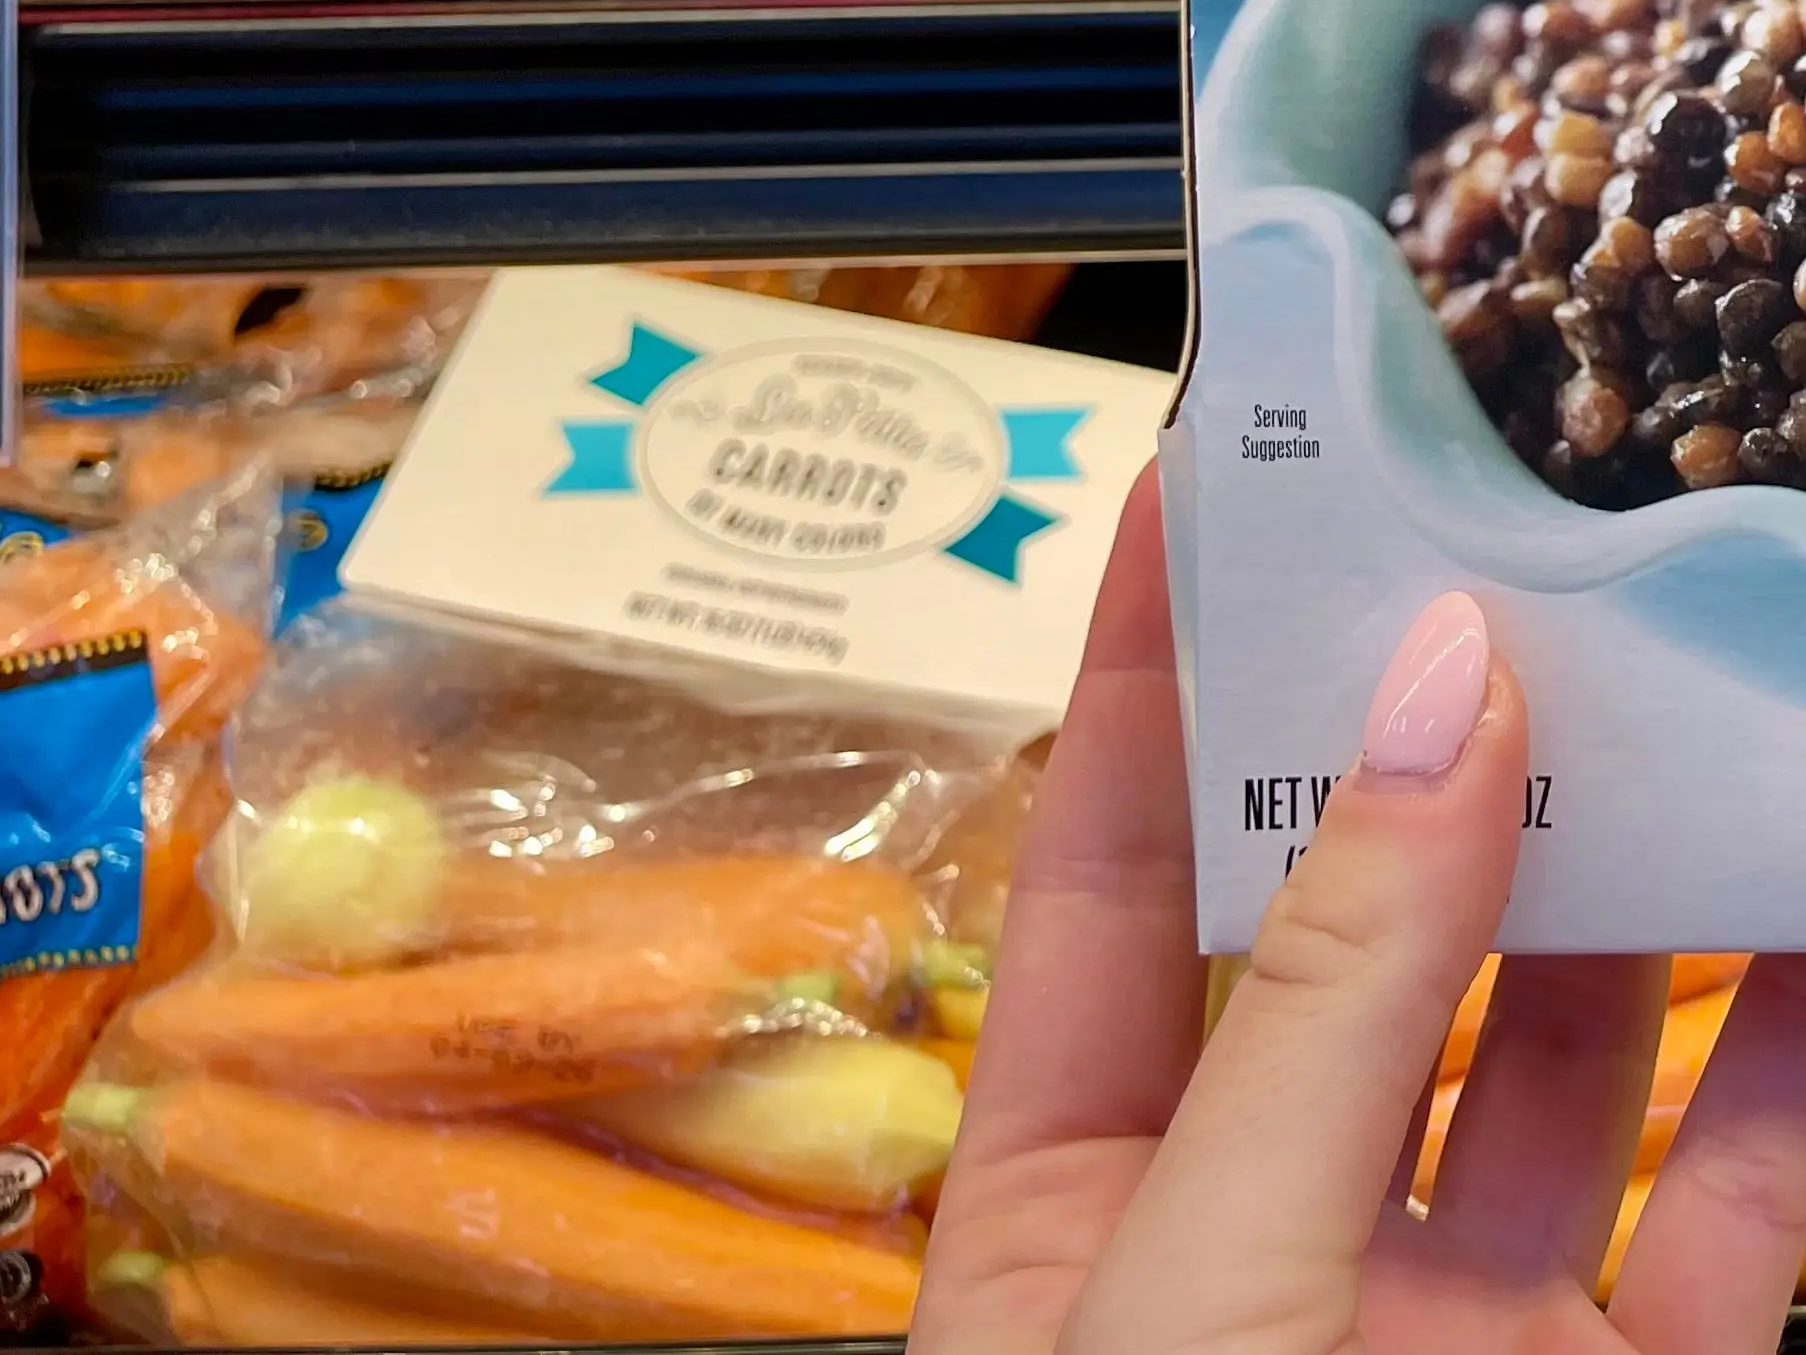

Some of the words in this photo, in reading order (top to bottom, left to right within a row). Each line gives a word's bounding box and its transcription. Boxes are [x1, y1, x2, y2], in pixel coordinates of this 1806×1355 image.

[1254, 404, 1307, 430] Serving
[1242, 434, 1320, 461] Suggestion
[708, 437, 908, 516] CARROTS
[1244, 776, 1302, 831] NET
[0, 848, 100, 923] OTS
